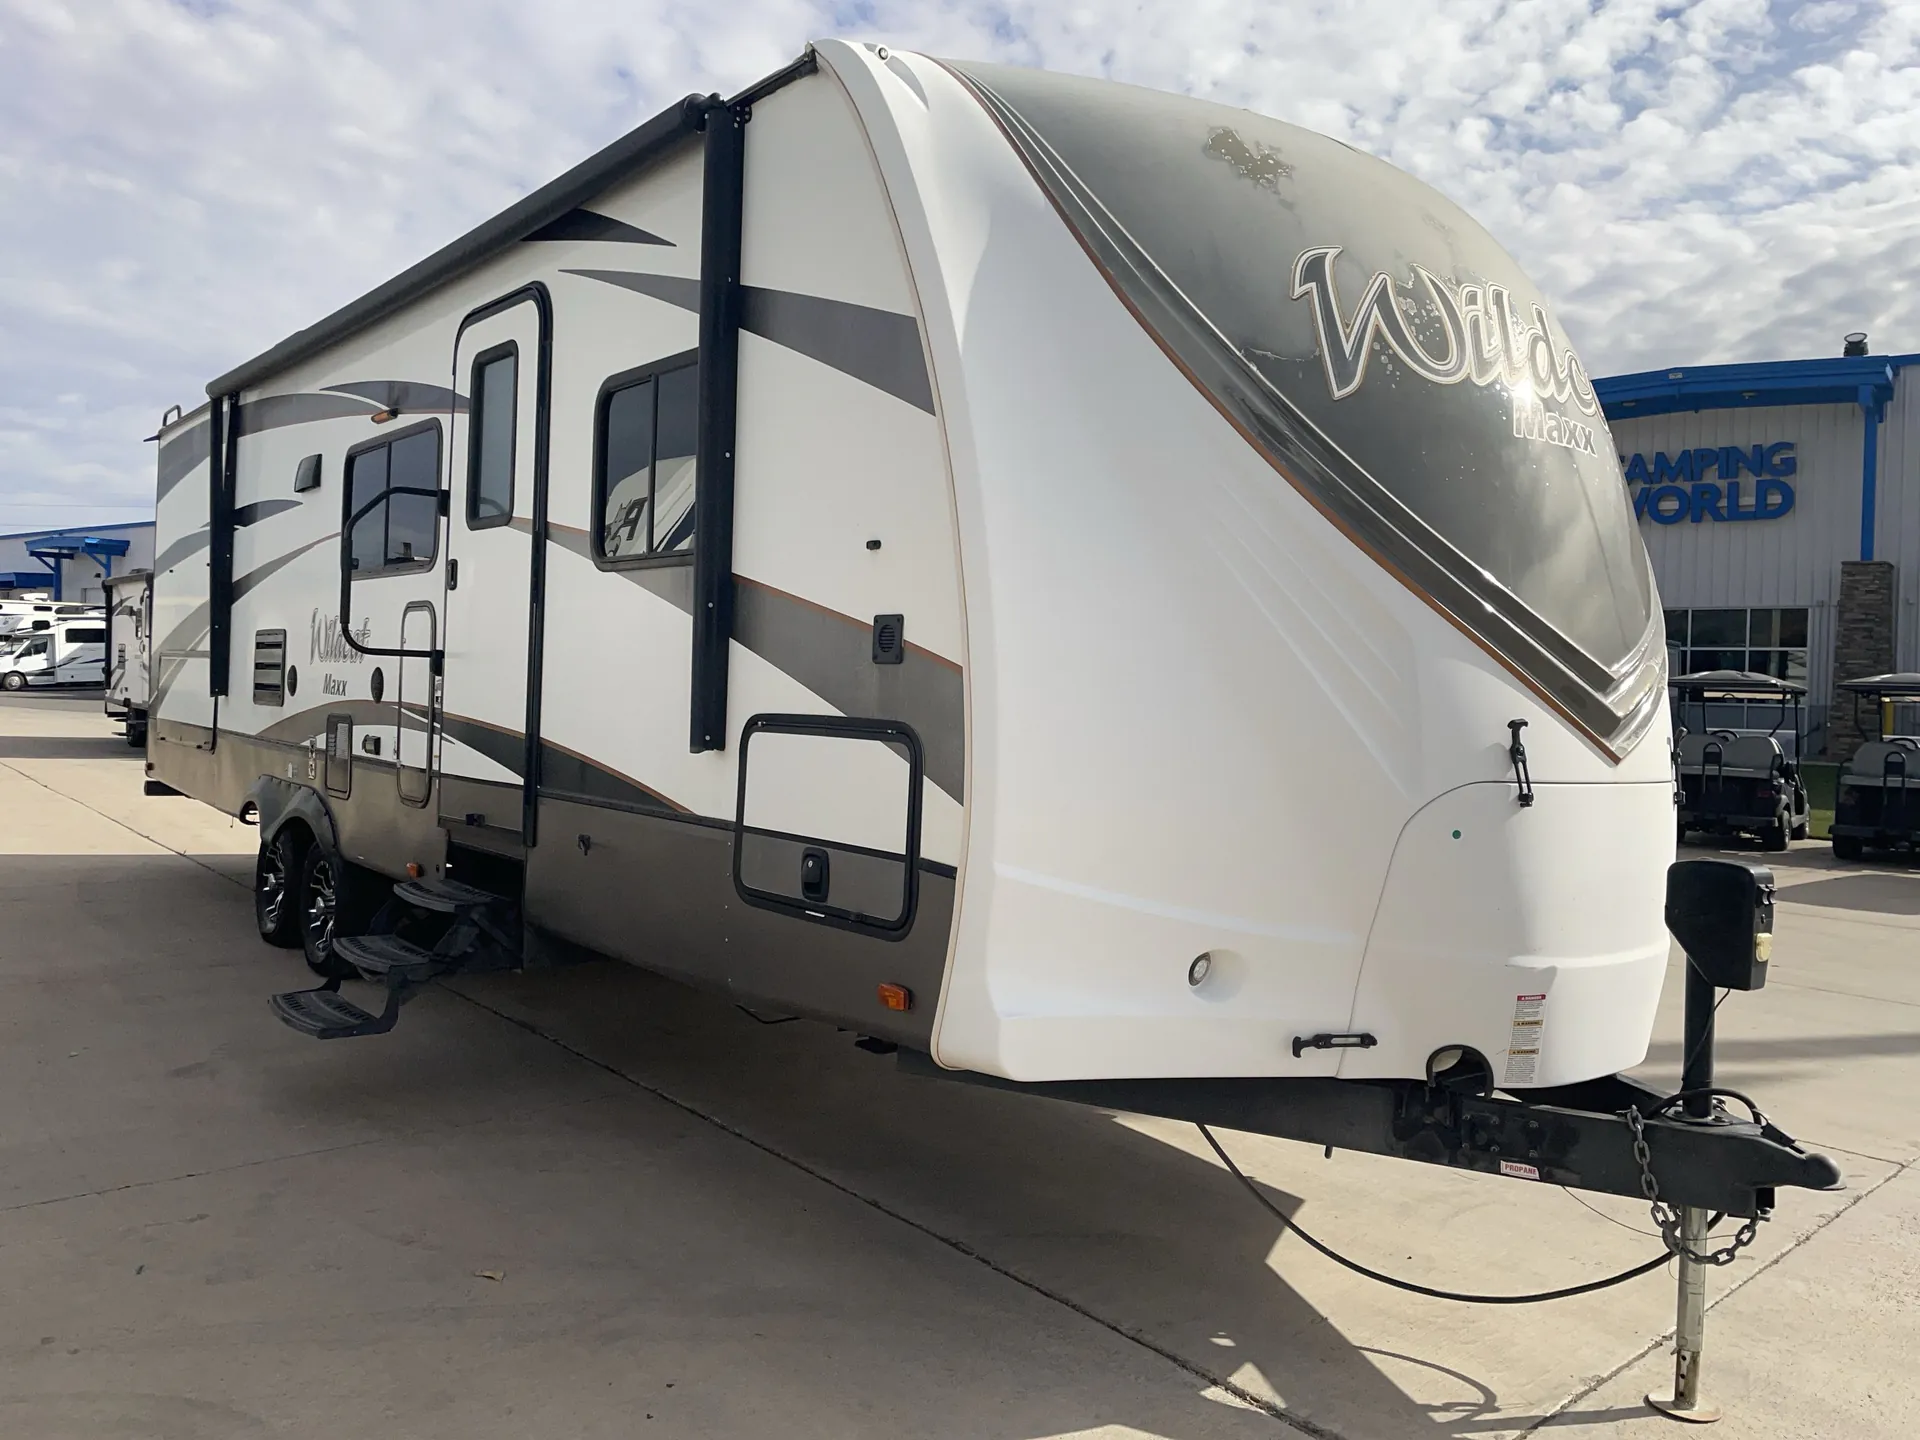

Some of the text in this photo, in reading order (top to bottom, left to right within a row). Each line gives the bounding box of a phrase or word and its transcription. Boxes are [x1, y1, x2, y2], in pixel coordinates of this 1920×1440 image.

[1512, 401, 1598, 457] Maxx
[1620, 441, 1797, 485] AMPING
[322, 673, 348, 696] Maxx
[1504, 1164, 1537, 1175] PROPANE
